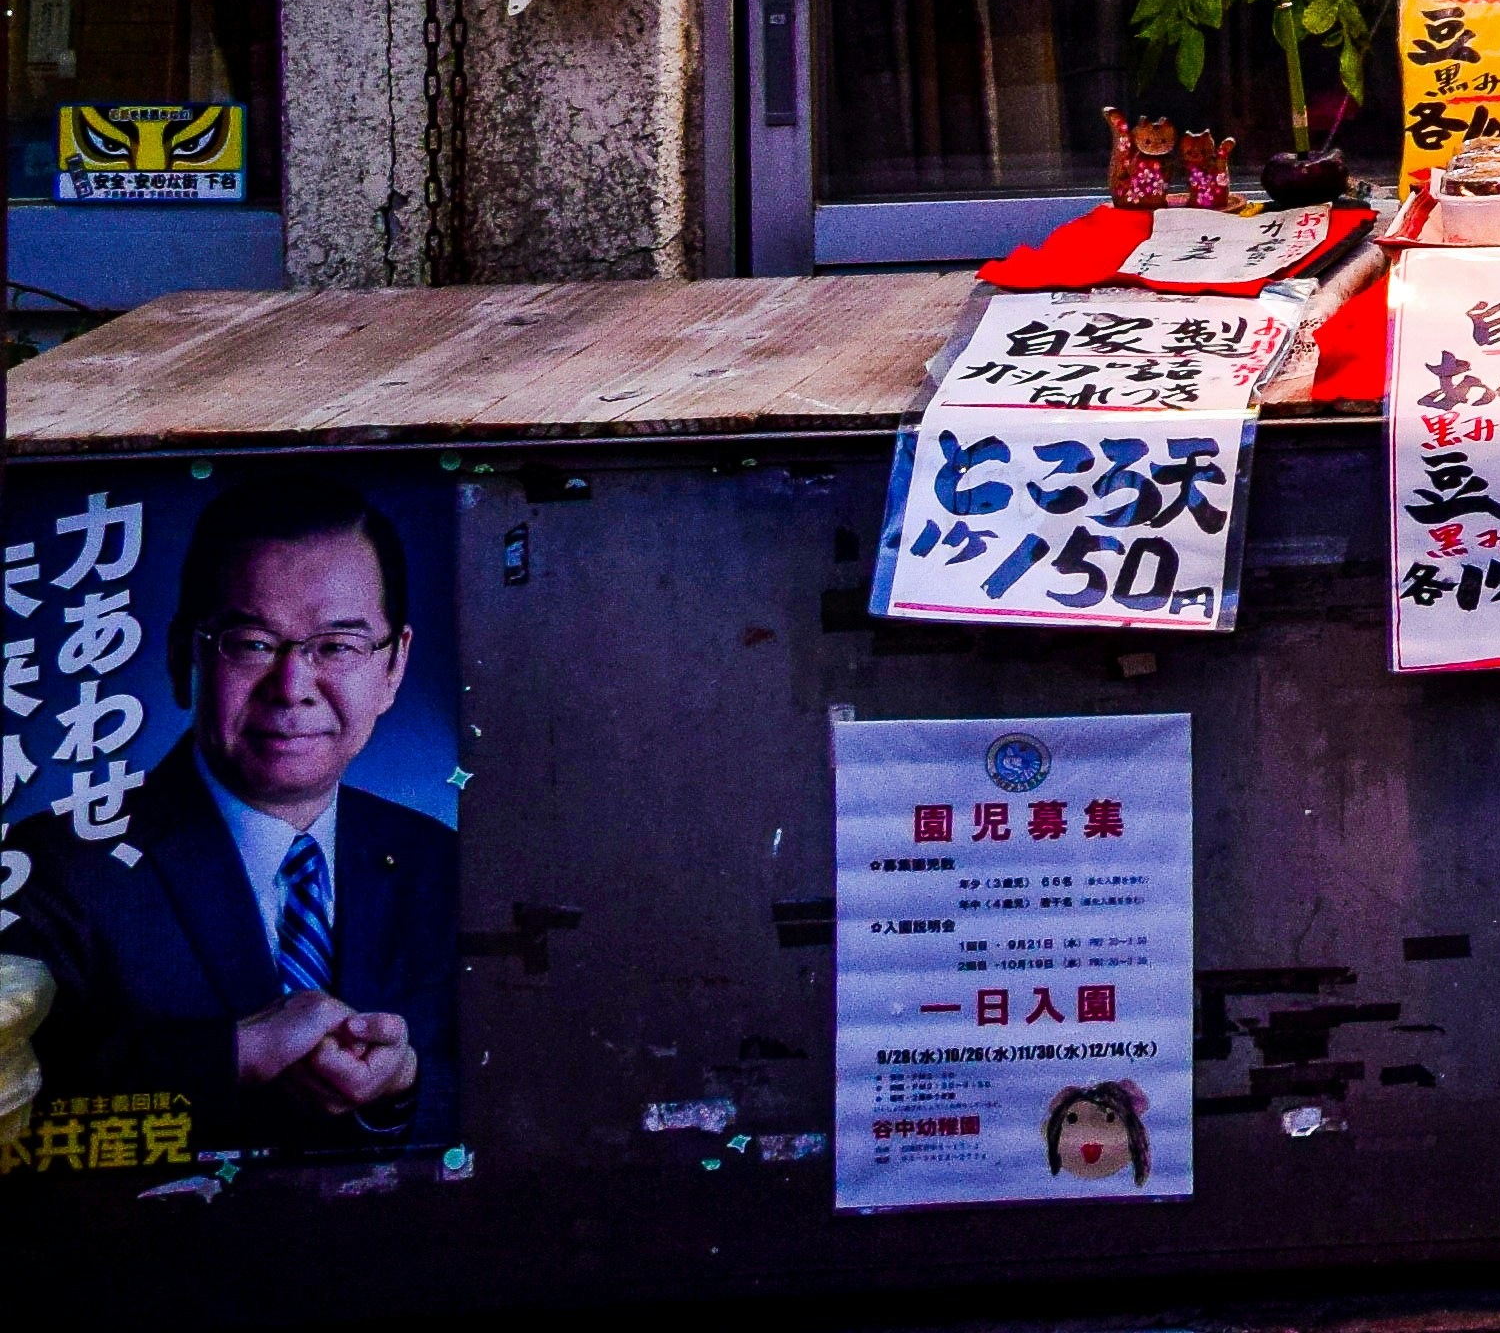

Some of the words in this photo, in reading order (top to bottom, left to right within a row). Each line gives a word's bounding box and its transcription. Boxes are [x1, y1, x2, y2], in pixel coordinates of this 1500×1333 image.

[1005, 317, 1252, 358] 自家製
[934, 430, 1228, 534] ところ天
[980, 525, 1214, 620] 150円
[51, 491, 145, 867] 力あわせ、
[914, 800, 1125, 844] 園児募集
[920, 984, 1116, 1025] 一日入園
[872, 1117, 980, 1139] 谷中幼稚園
